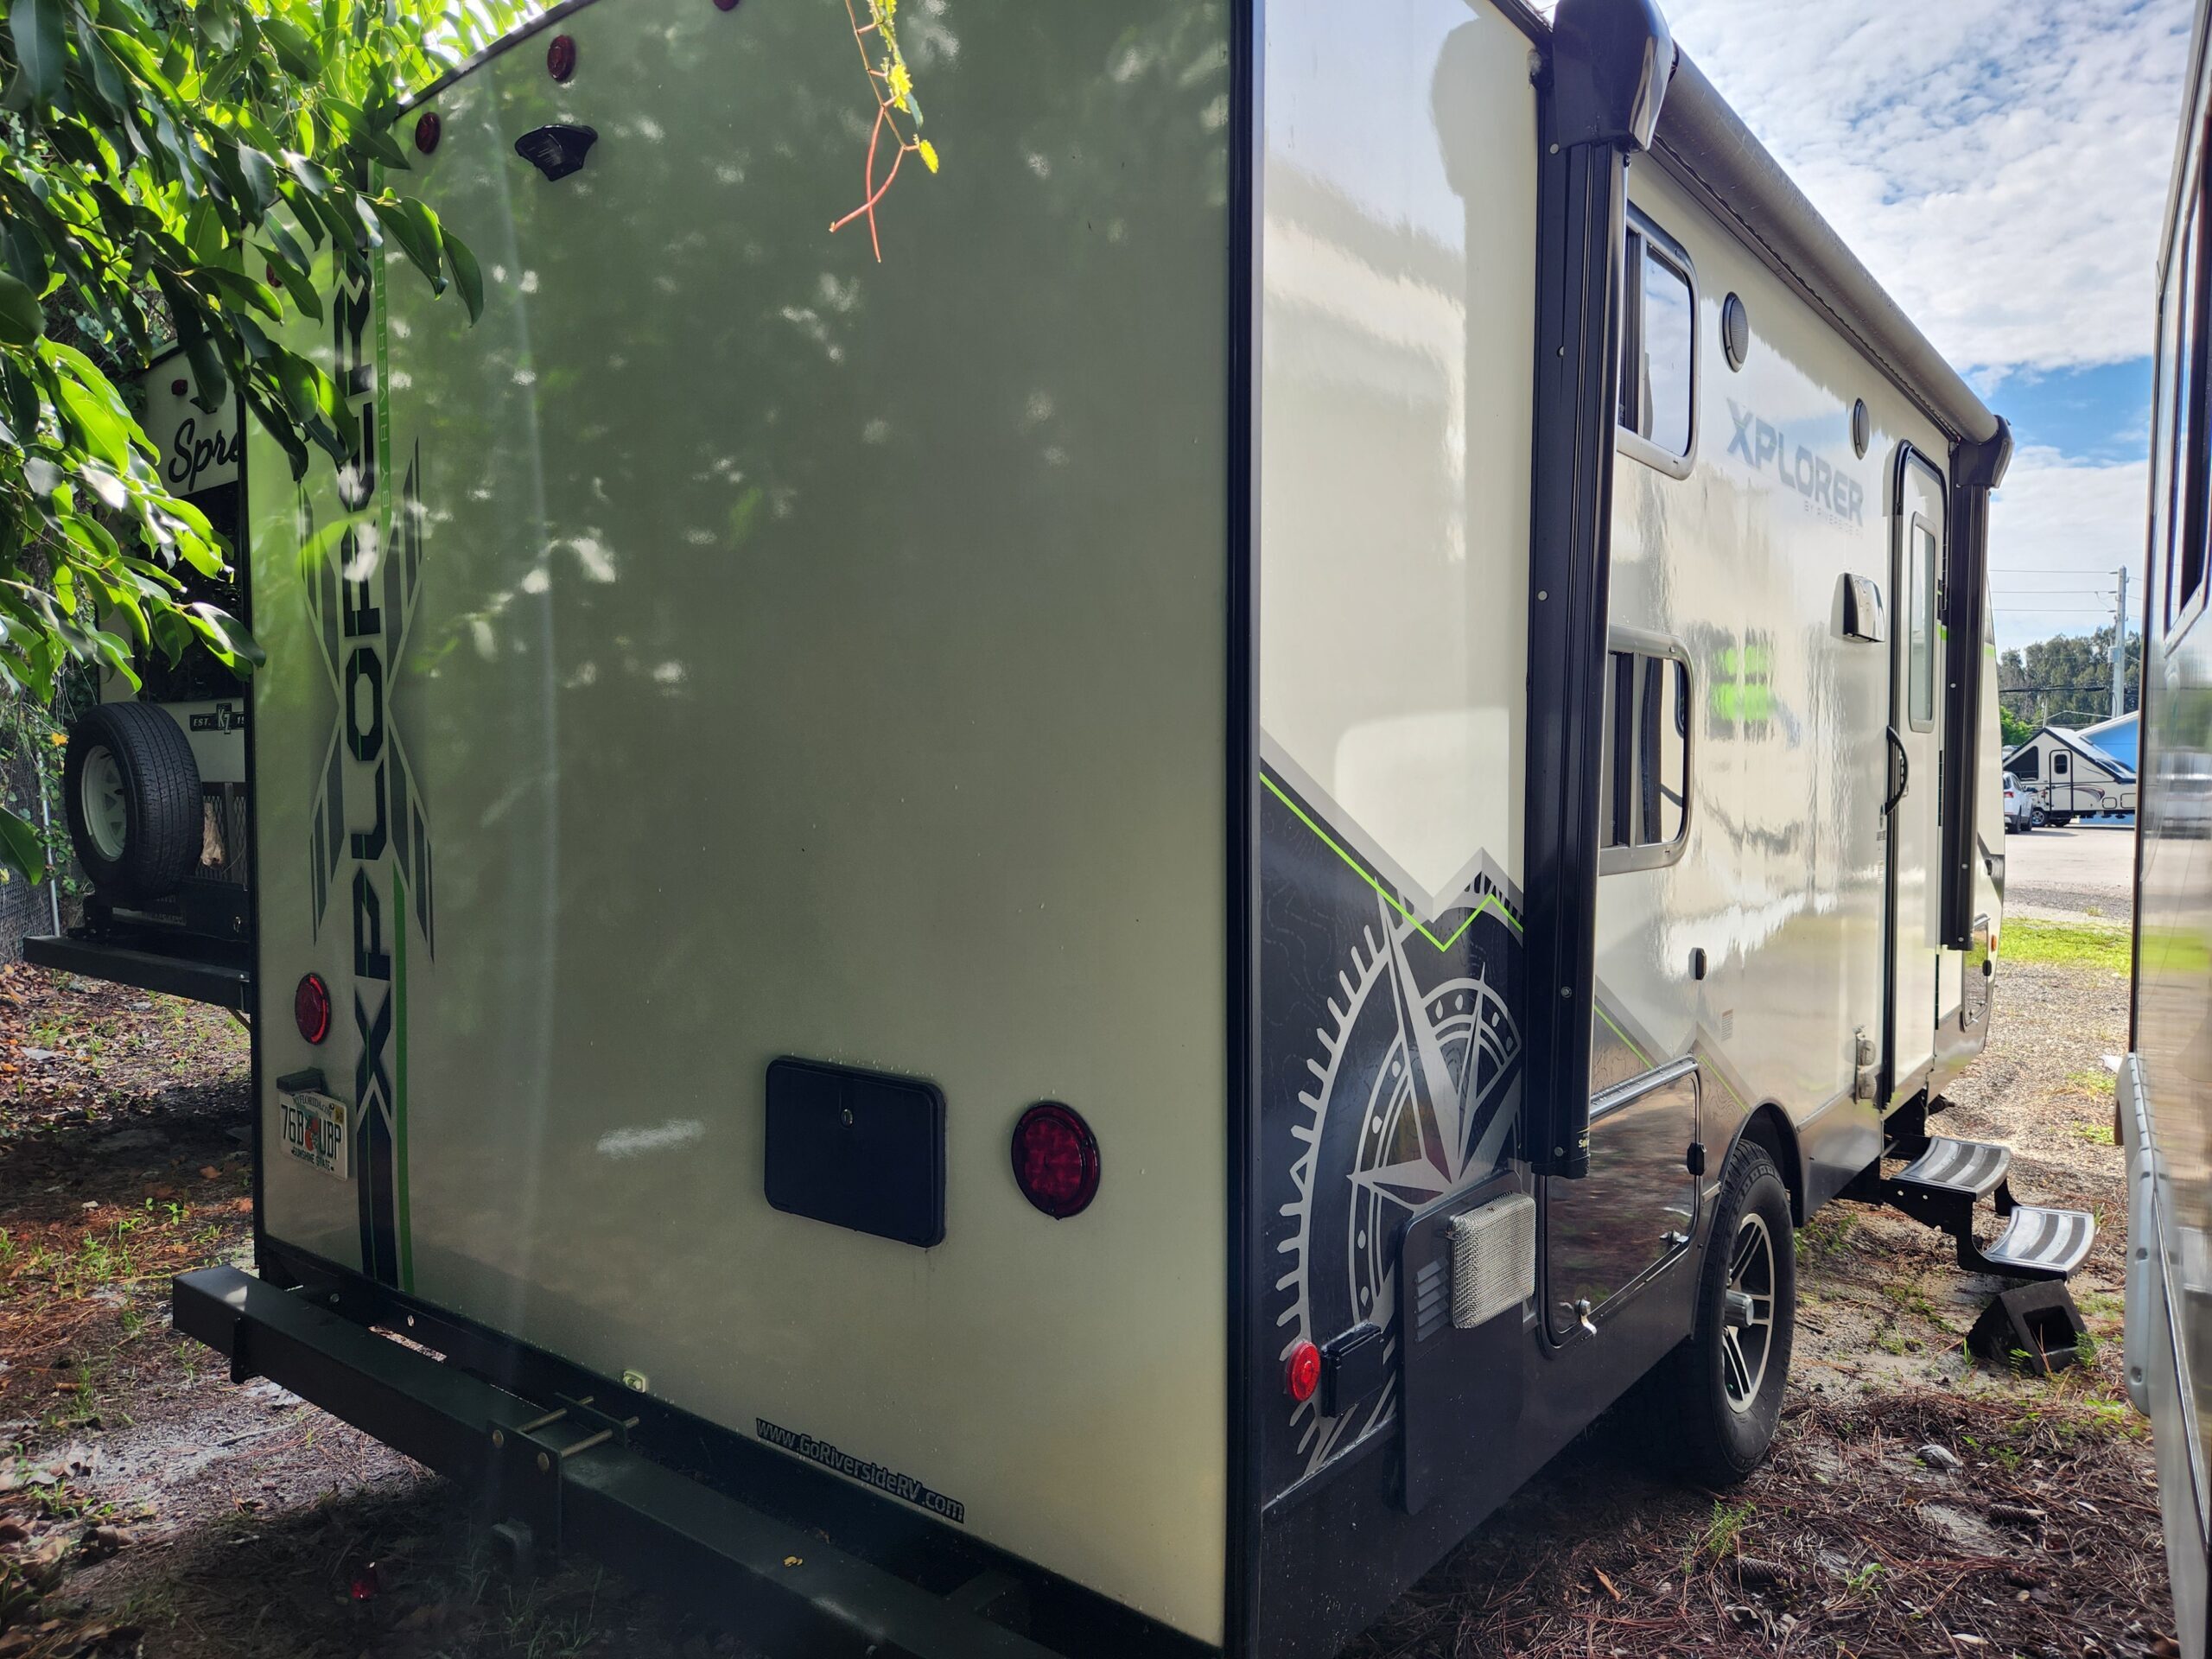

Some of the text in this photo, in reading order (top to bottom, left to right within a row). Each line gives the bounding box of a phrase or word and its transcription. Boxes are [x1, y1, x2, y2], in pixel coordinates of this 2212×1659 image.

[1726, 397, 1864, 527] XPLORER
[193, 717, 211, 727] EST.
[218, 709, 231, 734] KZ
[281, 1103, 304, 1147] 76B
[319, 1118, 342, 1160] UBP
